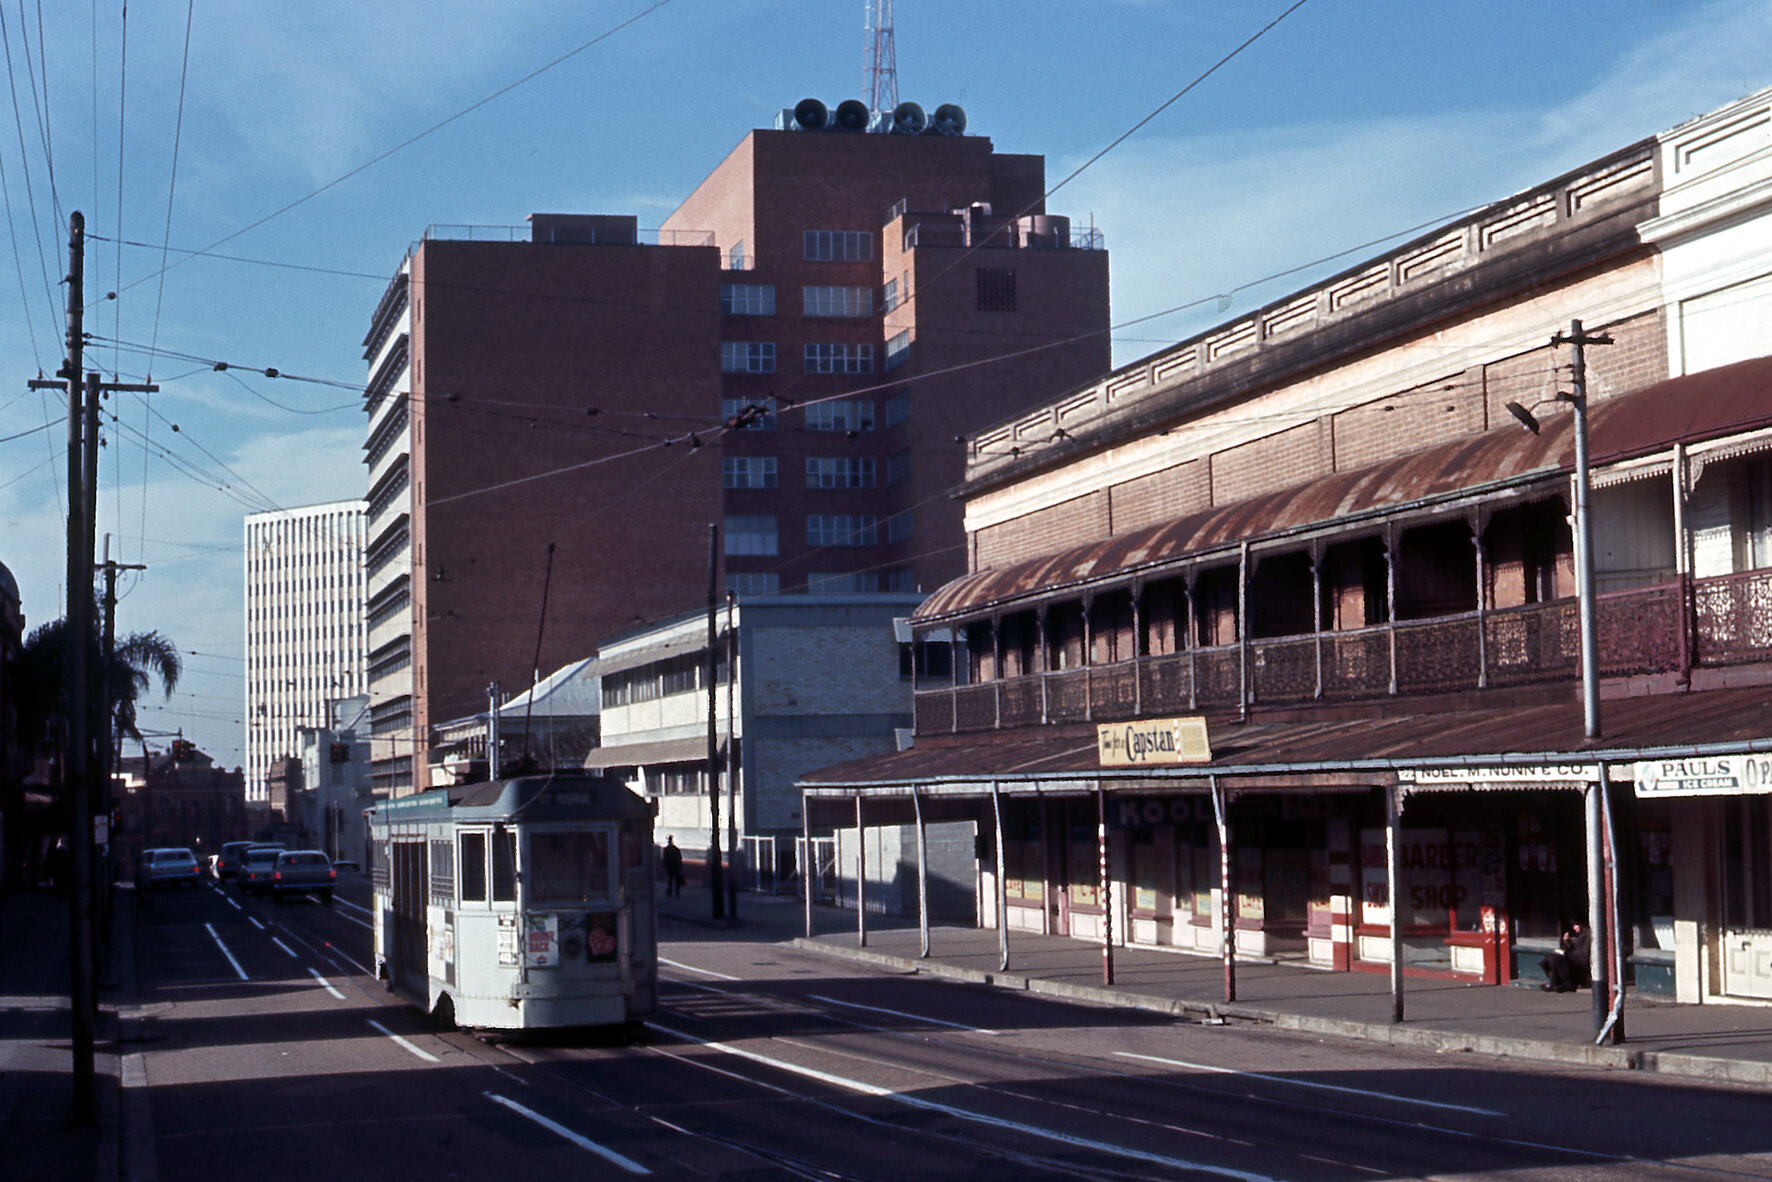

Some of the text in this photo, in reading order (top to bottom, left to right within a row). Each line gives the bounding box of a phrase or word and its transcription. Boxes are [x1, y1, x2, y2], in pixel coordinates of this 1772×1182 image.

[1126, 725, 1175, 762] Capstan
[1490, 766, 1535, 777] NUNN
[1557, 765, 1589, 775] CO.
[1662, 760, 1731, 777] PAULS
[1683, 780, 1699, 789] ICE
[1701, 778, 1733, 788] CREAM
[1120, 800, 1211, 826] KOOL
[1411, 884, 1467, 910] SHOP
